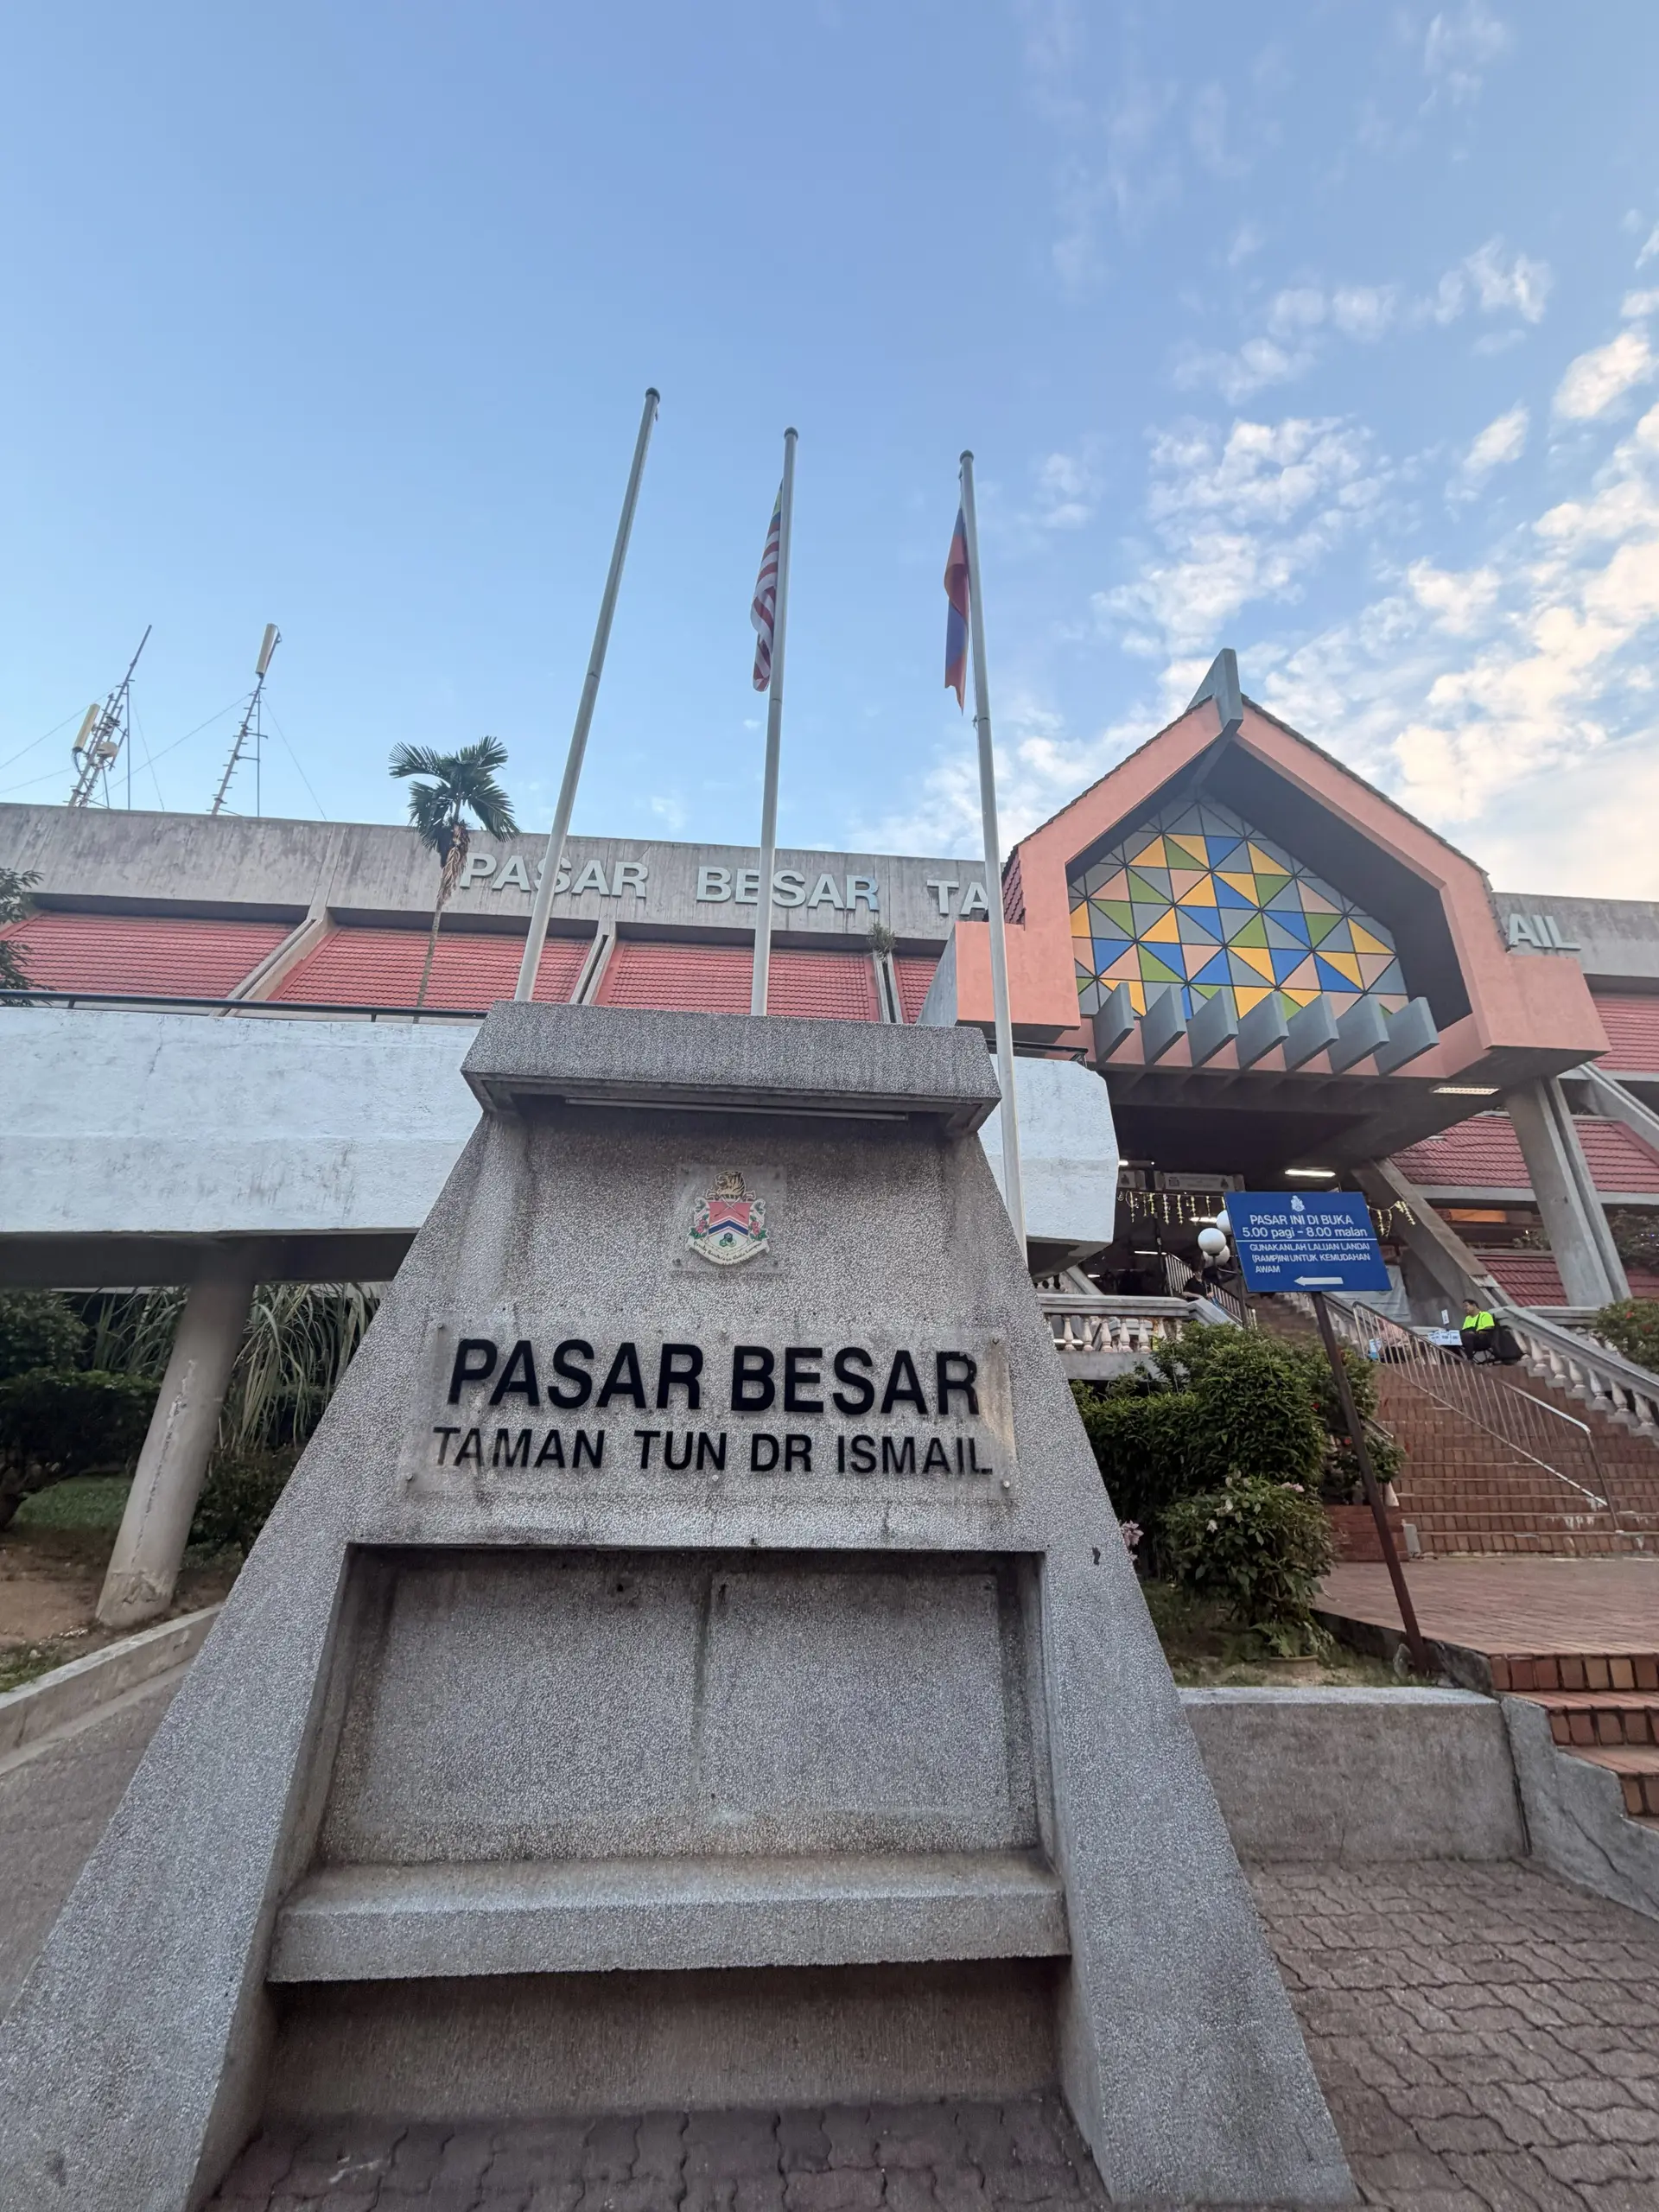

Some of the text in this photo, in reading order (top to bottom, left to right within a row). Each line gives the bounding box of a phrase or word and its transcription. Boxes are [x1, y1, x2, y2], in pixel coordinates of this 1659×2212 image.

[459, 852, 649, 898] PASAR
[696, 866, 880, 912] BESAR
[1249, 1214, 1354, 1225] PASAR INI DI BUKA
[1243, 1227, 1268, 1237] 5.00
[1271, 1226, 1295, 1239] pagi
[1306, 1226, 1332, 1237] 8.00
[1249, 1243, 1307, 1251] GUNAKANLAH
[1307, 1243, 1340, 1251] LALUAN
[1319, 1253, 1371, 1262] KEMUDAHAN
[447, 1338, 980, 1415] PASAR BESAR
[433, 1427, 994, 1476] TAMAN TUN DR ISMAIL
